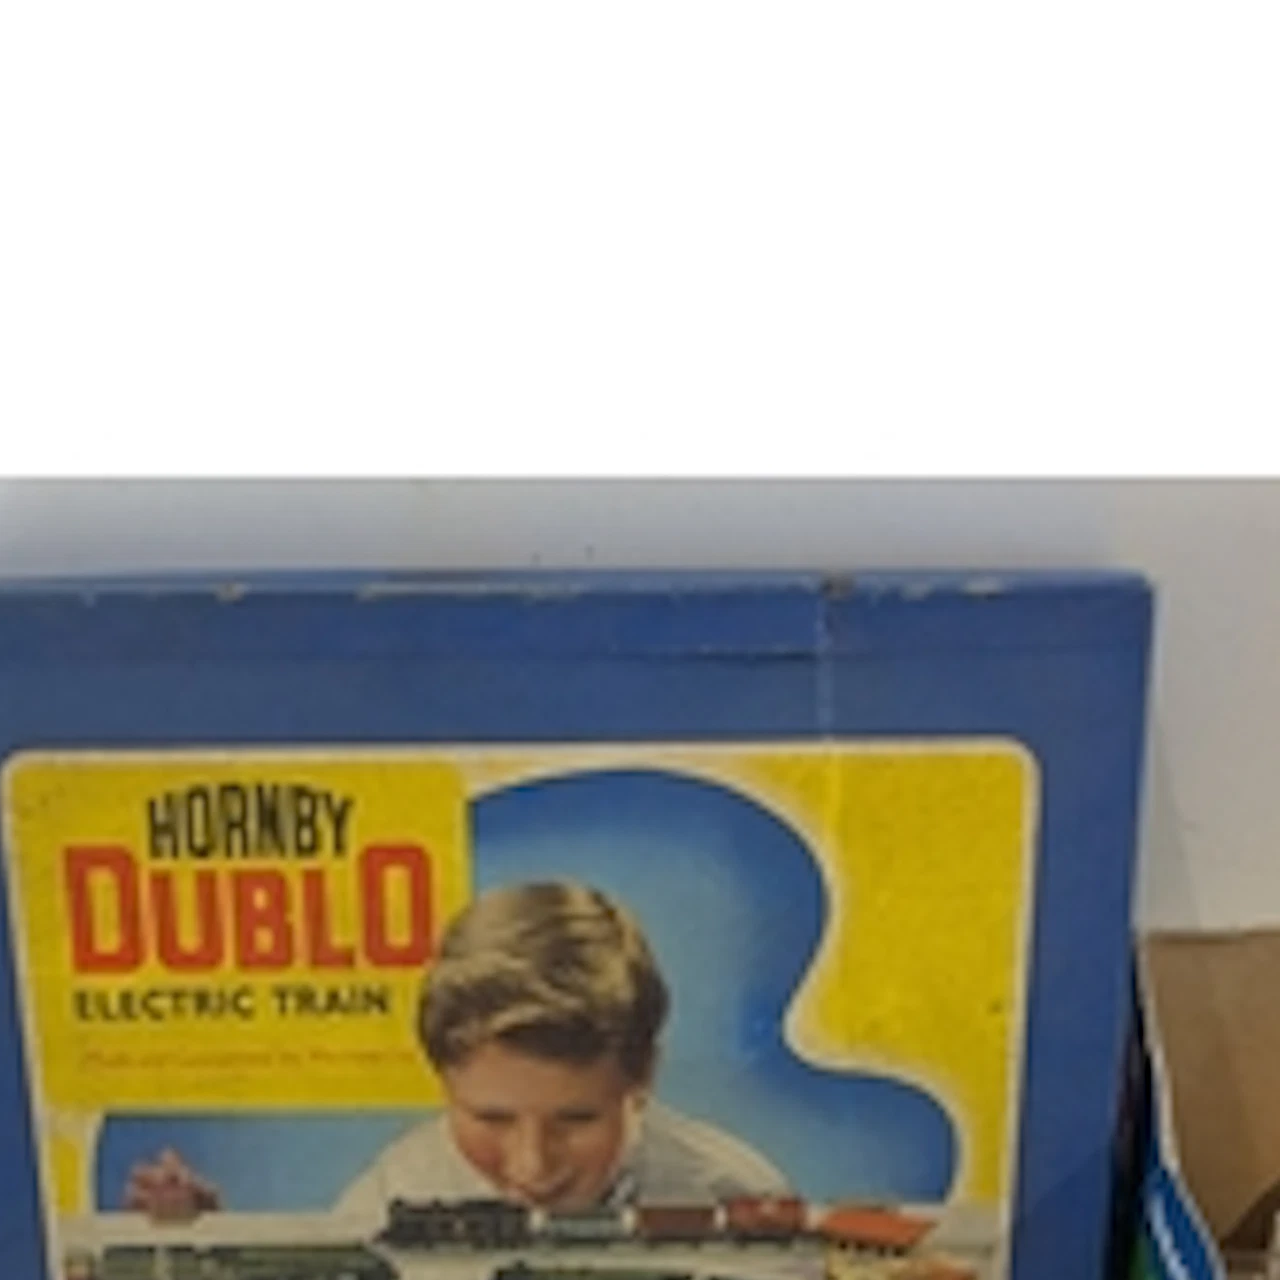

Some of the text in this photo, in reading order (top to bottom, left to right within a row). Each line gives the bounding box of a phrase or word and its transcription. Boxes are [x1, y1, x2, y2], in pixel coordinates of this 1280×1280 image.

[148, 783, 354, 862] HORNBY
[63, 843, 434, 976] DUBLO
[74, 983, 391, 1024] ELECTRIC TRAIN
